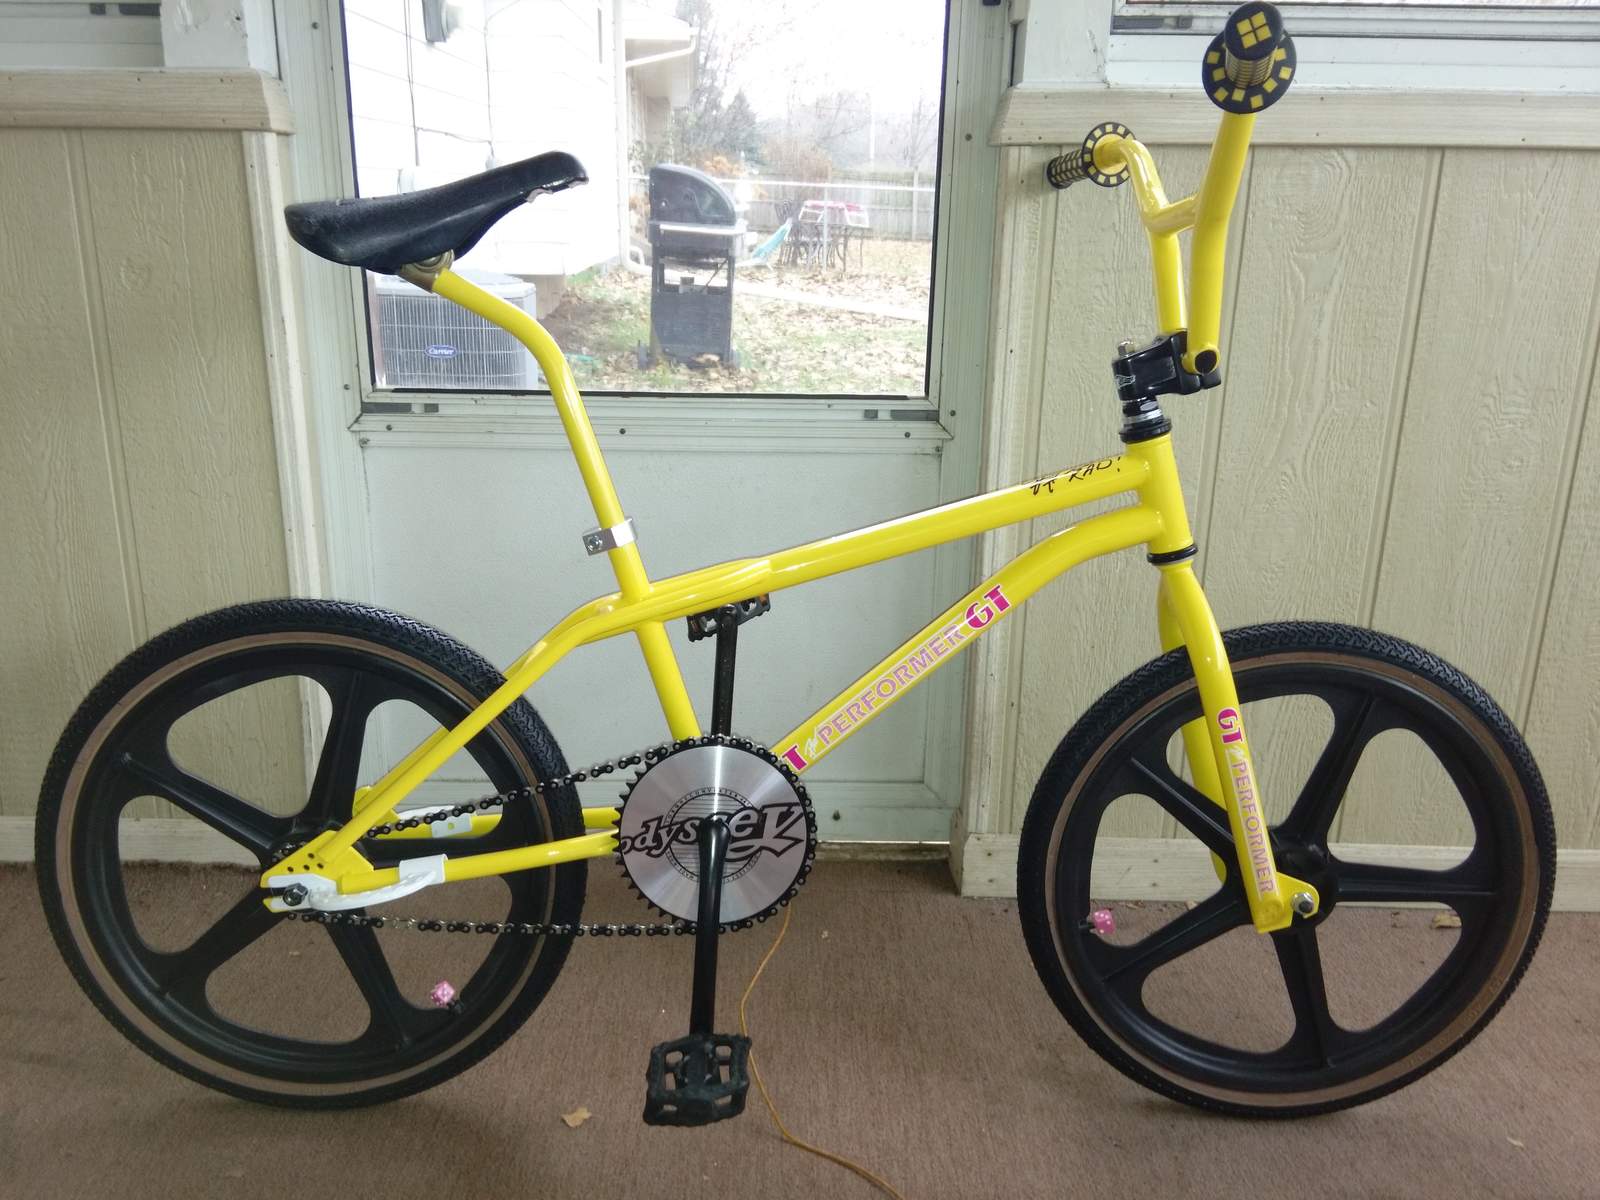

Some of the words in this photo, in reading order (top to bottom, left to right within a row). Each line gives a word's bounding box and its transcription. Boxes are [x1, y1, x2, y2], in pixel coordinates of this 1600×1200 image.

[817, 623, 967, 745] PERFORMER
[964, 584, 1012, 629] GT
[1217, 708, 1244, 744] GT
[1231, 759, 1275, 893] PERFORMER
